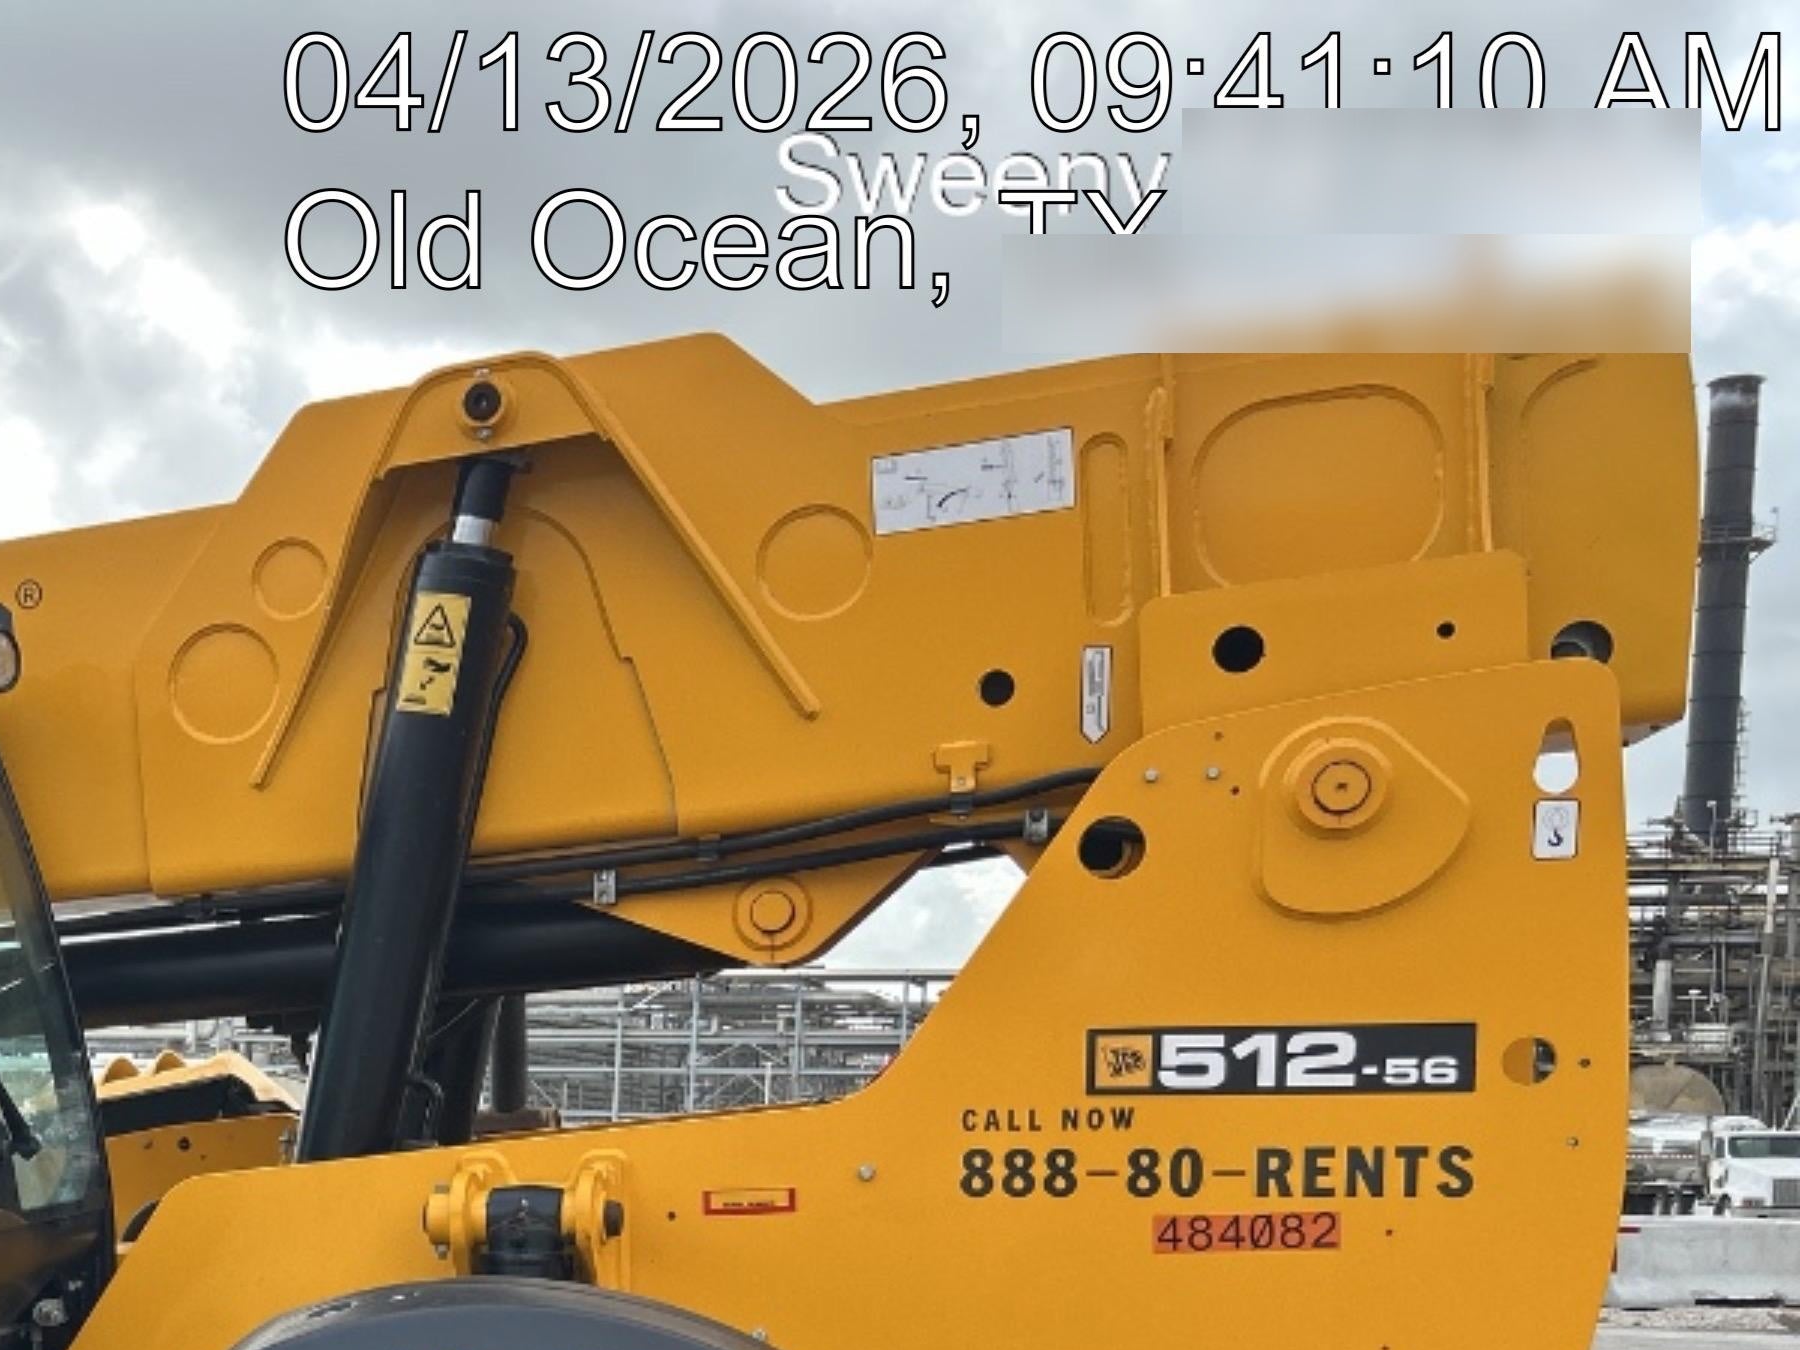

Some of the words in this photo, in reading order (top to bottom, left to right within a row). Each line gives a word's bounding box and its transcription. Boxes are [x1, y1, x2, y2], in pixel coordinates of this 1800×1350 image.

[1158, 1031, 1460, 1090] 512-56
[961, 1109, 1043, 1132] CALL
[1061, 1107, 1135, 1131] NOW
[960, 1146, 1475, 1199] 888-80-RENTS
[1156, 1211, 1340, 1252] 484082
